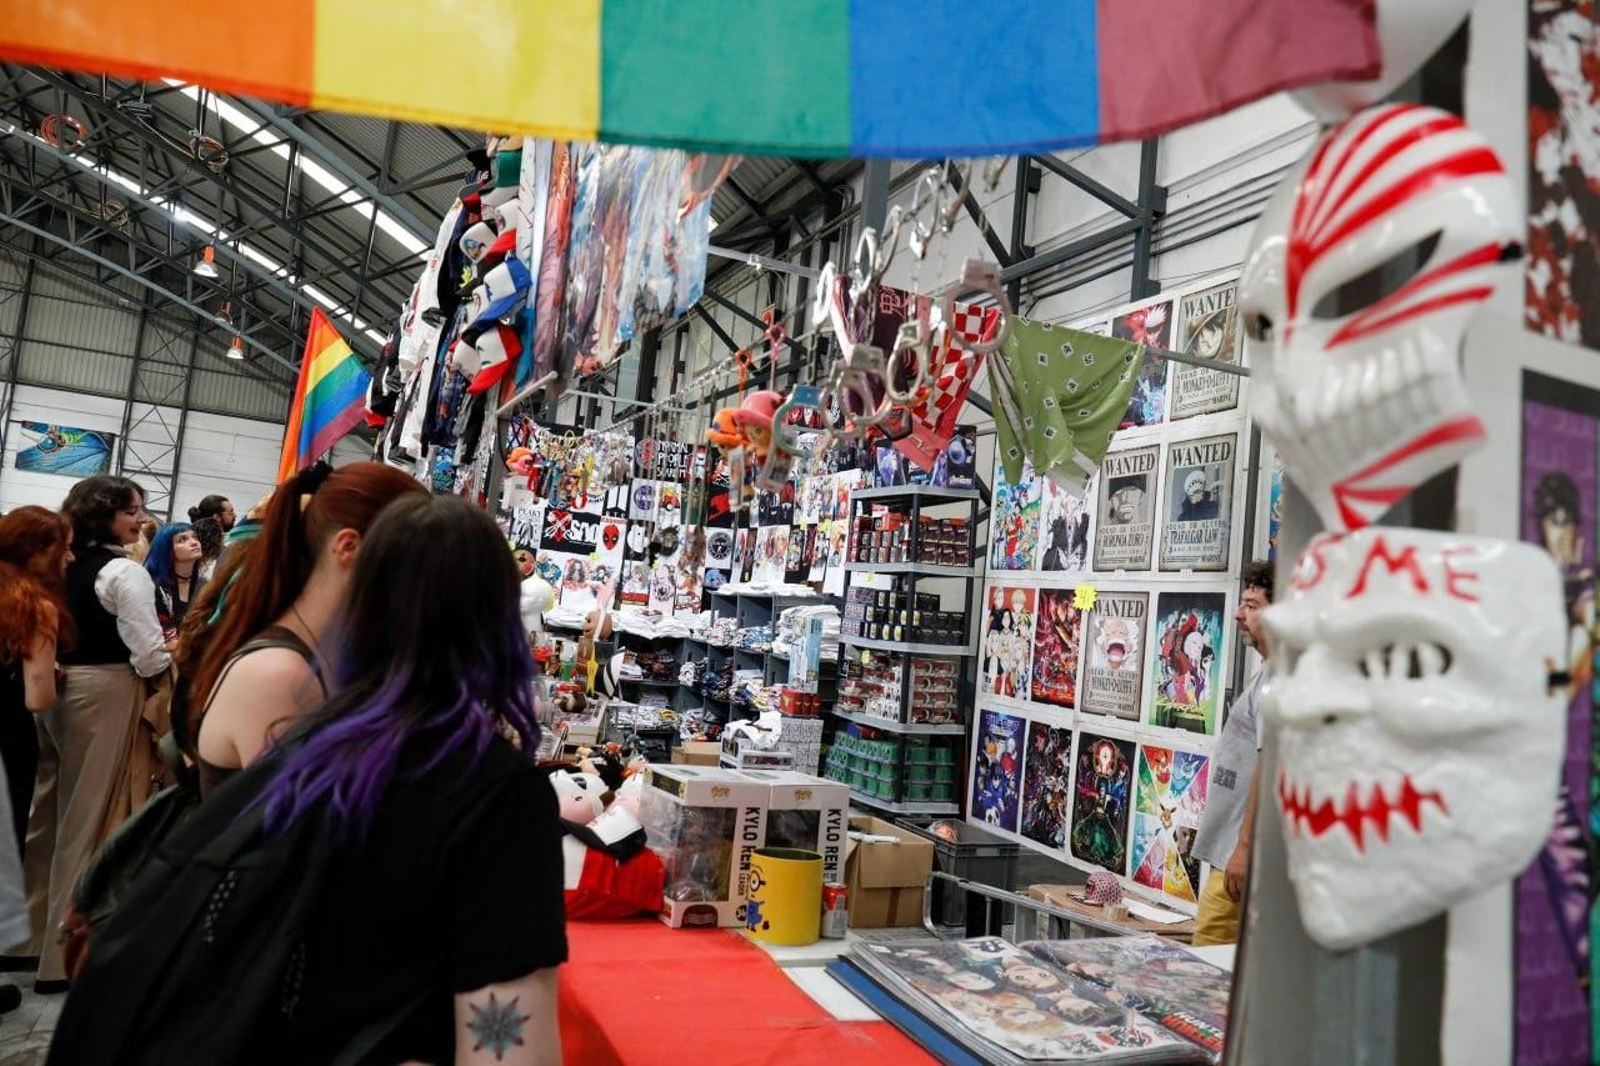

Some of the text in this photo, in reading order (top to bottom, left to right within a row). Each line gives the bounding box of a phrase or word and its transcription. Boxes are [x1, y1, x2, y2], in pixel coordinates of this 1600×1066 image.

[1105, 453, 1155, 476] WANTED
[1172, 441, 1231, 466] WANTED
[519, 507, 541, 518] PEAKY
[1095, 600, 1145, 618] WANTED
[826, 809, 841, 842] KYLO
[740, 807, 761, 871] KYLO REN
[824, 846, 839, 871] REN
